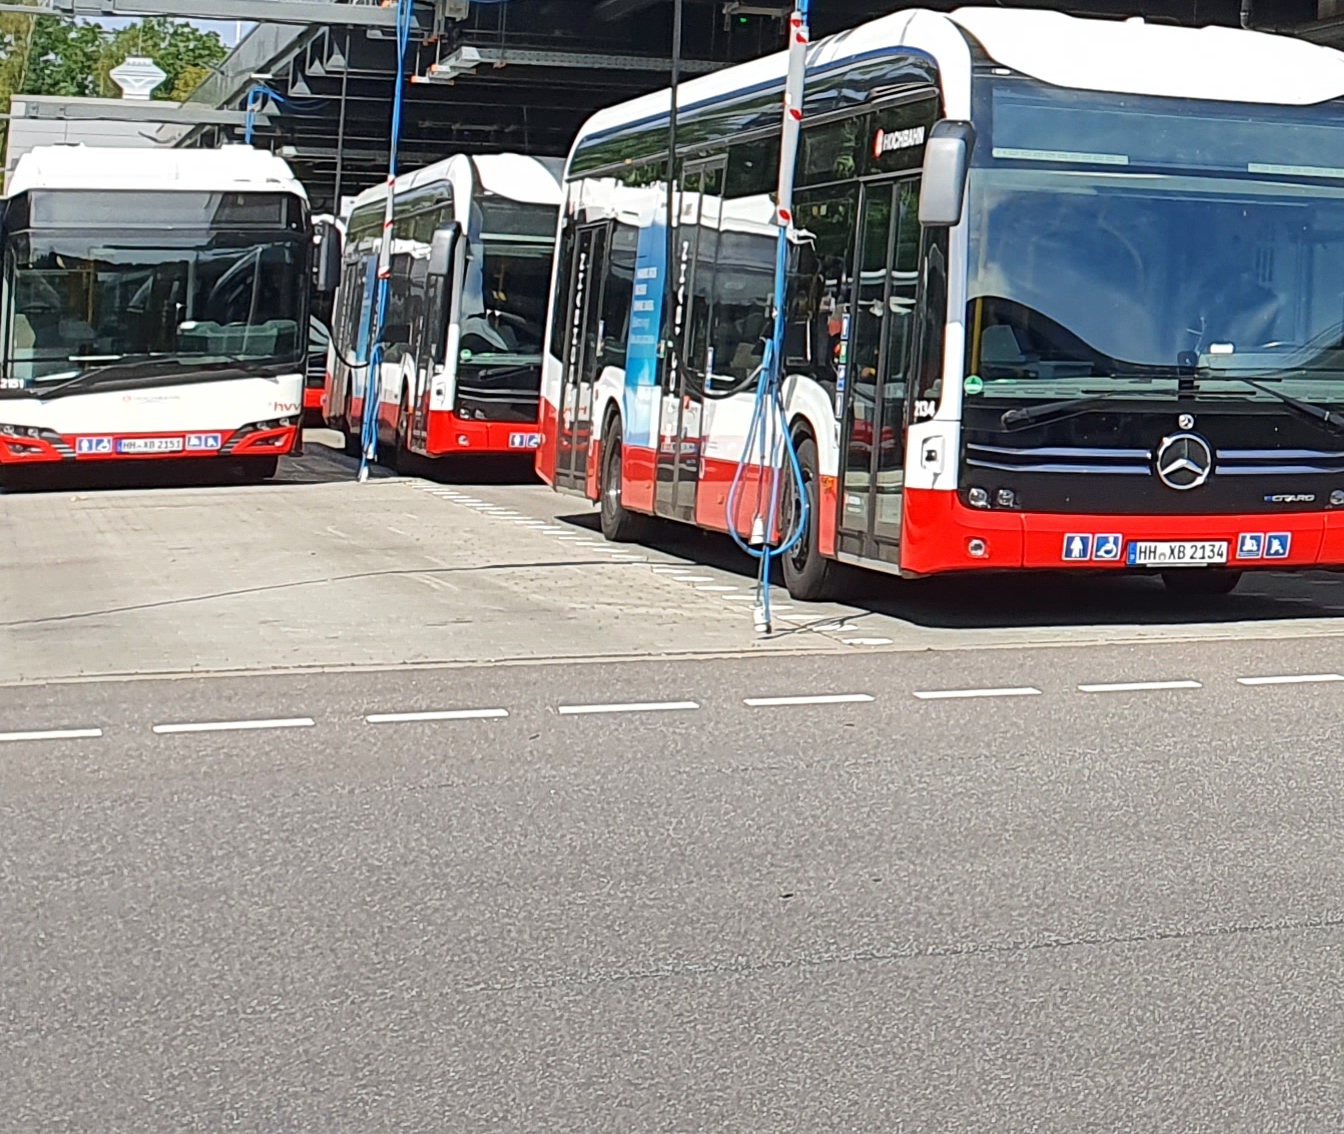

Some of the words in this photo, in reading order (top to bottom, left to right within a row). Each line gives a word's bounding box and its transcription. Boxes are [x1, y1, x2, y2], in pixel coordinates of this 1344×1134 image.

[157, 439, 181, 450] 2151
[1138, 544, 1157, 561] HH
[1167, 545, 1186, 561] XB
[1189, 544, 1224, 560] 2134
